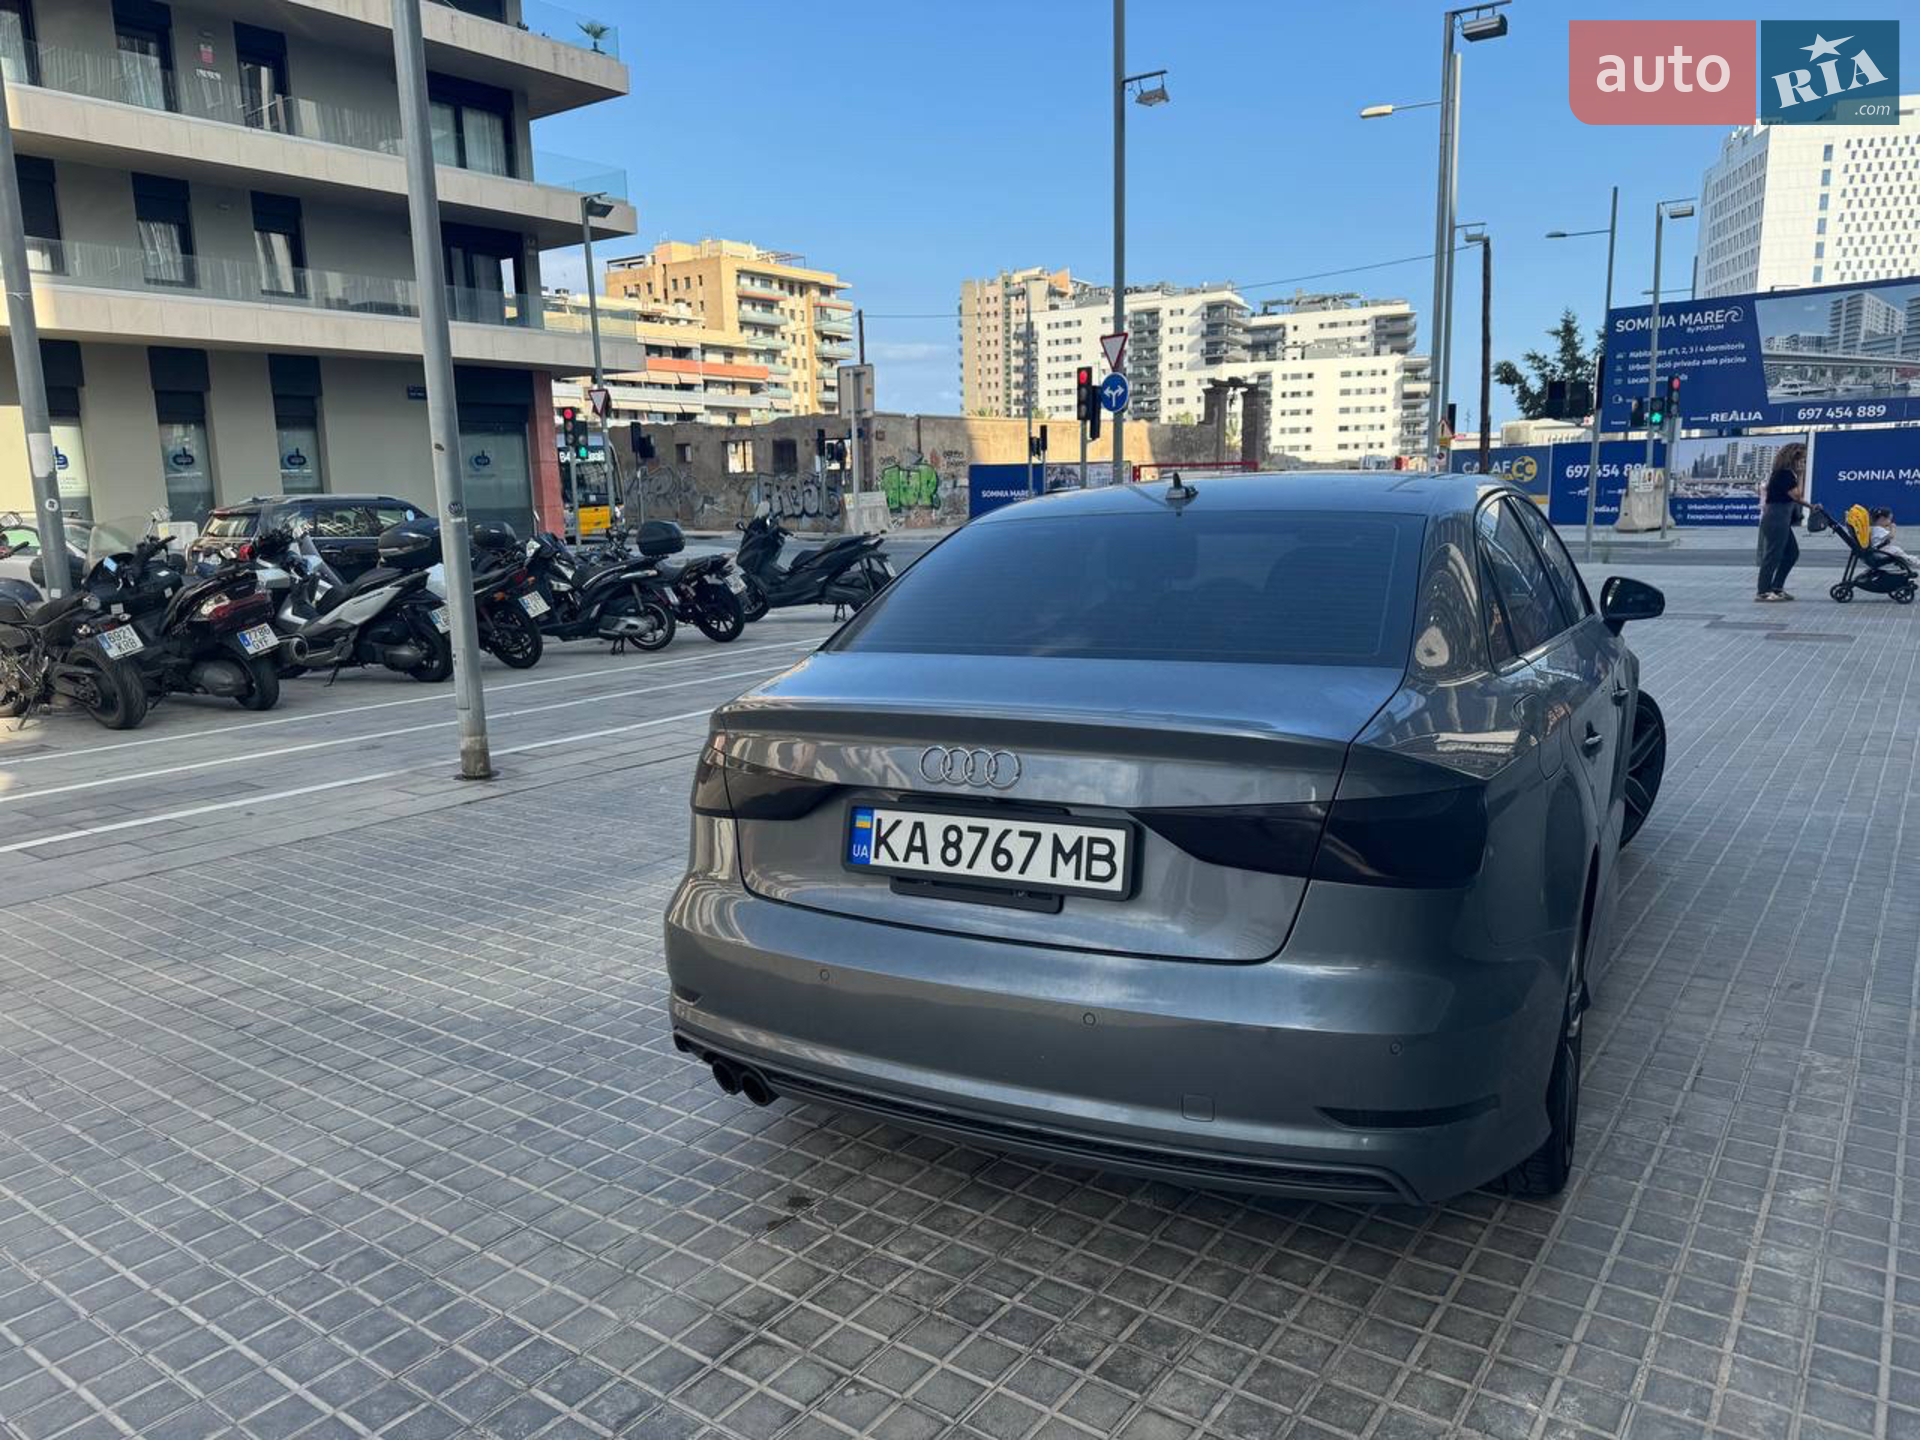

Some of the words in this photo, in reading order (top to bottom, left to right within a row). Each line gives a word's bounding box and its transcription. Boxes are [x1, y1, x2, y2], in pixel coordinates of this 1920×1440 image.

[1680, 309, 1726, 327] MARE
[1719, 355, 1747, 365] piscina
[1797, 407, 1823, 420] 697
[1826, 406, 1852, 418] 454
[1857, 404, 1887, 417] 889
[1462, 460, 1511, 475] CAAF
[1566, 464, 1590, 478] 697
[1838, 469, 1895, 481] SOMNIA
[852, 844, 869, 858] UA
[873, 817, 929, 865] KA
[940, 824, 1042, 875] 8767
[1049, 832, 1117, 883] MB
